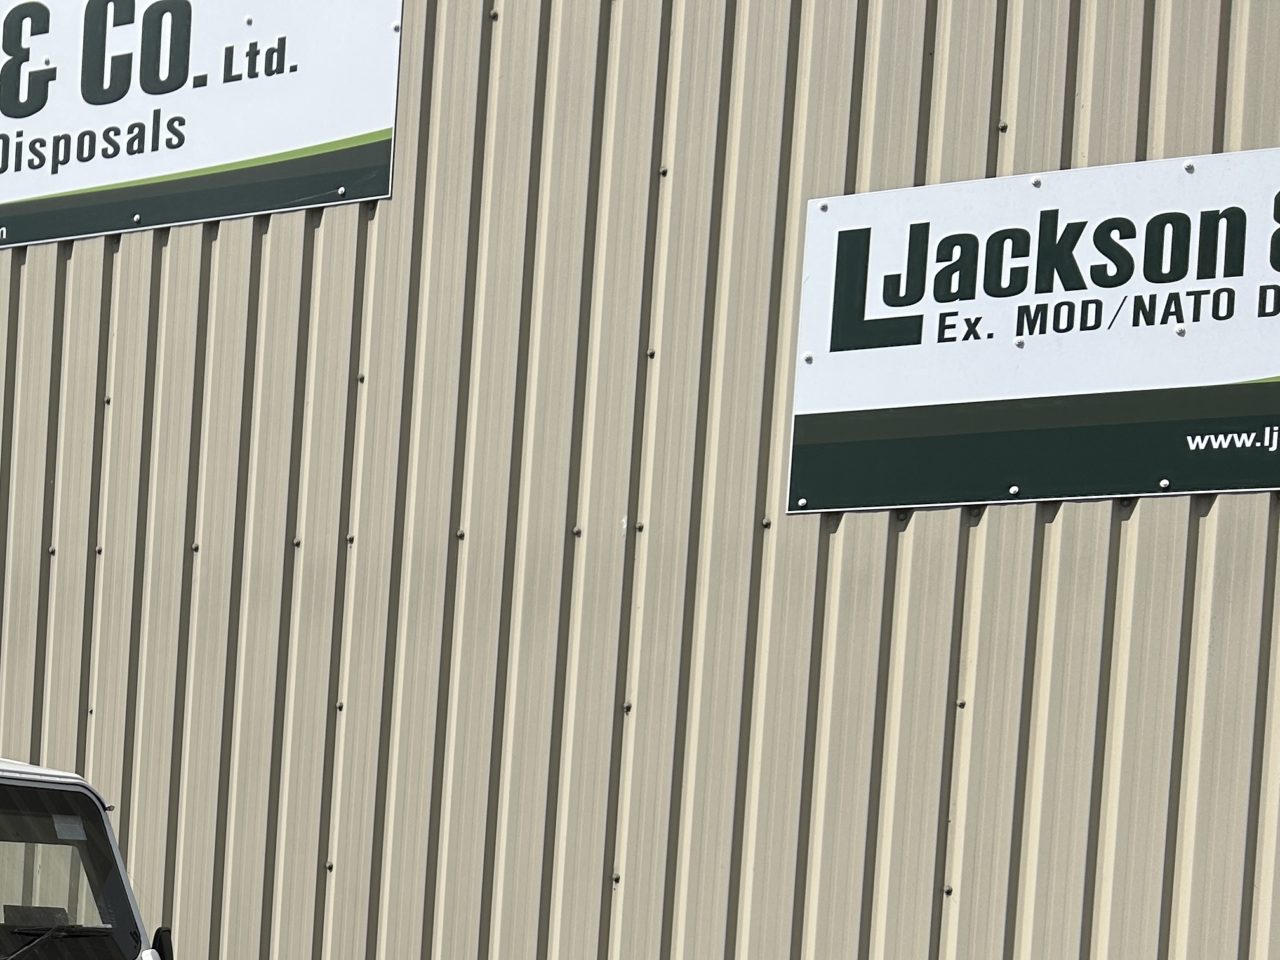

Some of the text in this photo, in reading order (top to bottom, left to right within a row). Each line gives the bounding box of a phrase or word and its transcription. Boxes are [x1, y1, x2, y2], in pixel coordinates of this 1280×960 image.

[80, 0, 208, 105] Co.
[222, 36, 298, 84] Ltd.
[937, 311, 995, 344] Ex.
[1014, 287, 1236, 337] MOD/NATO
